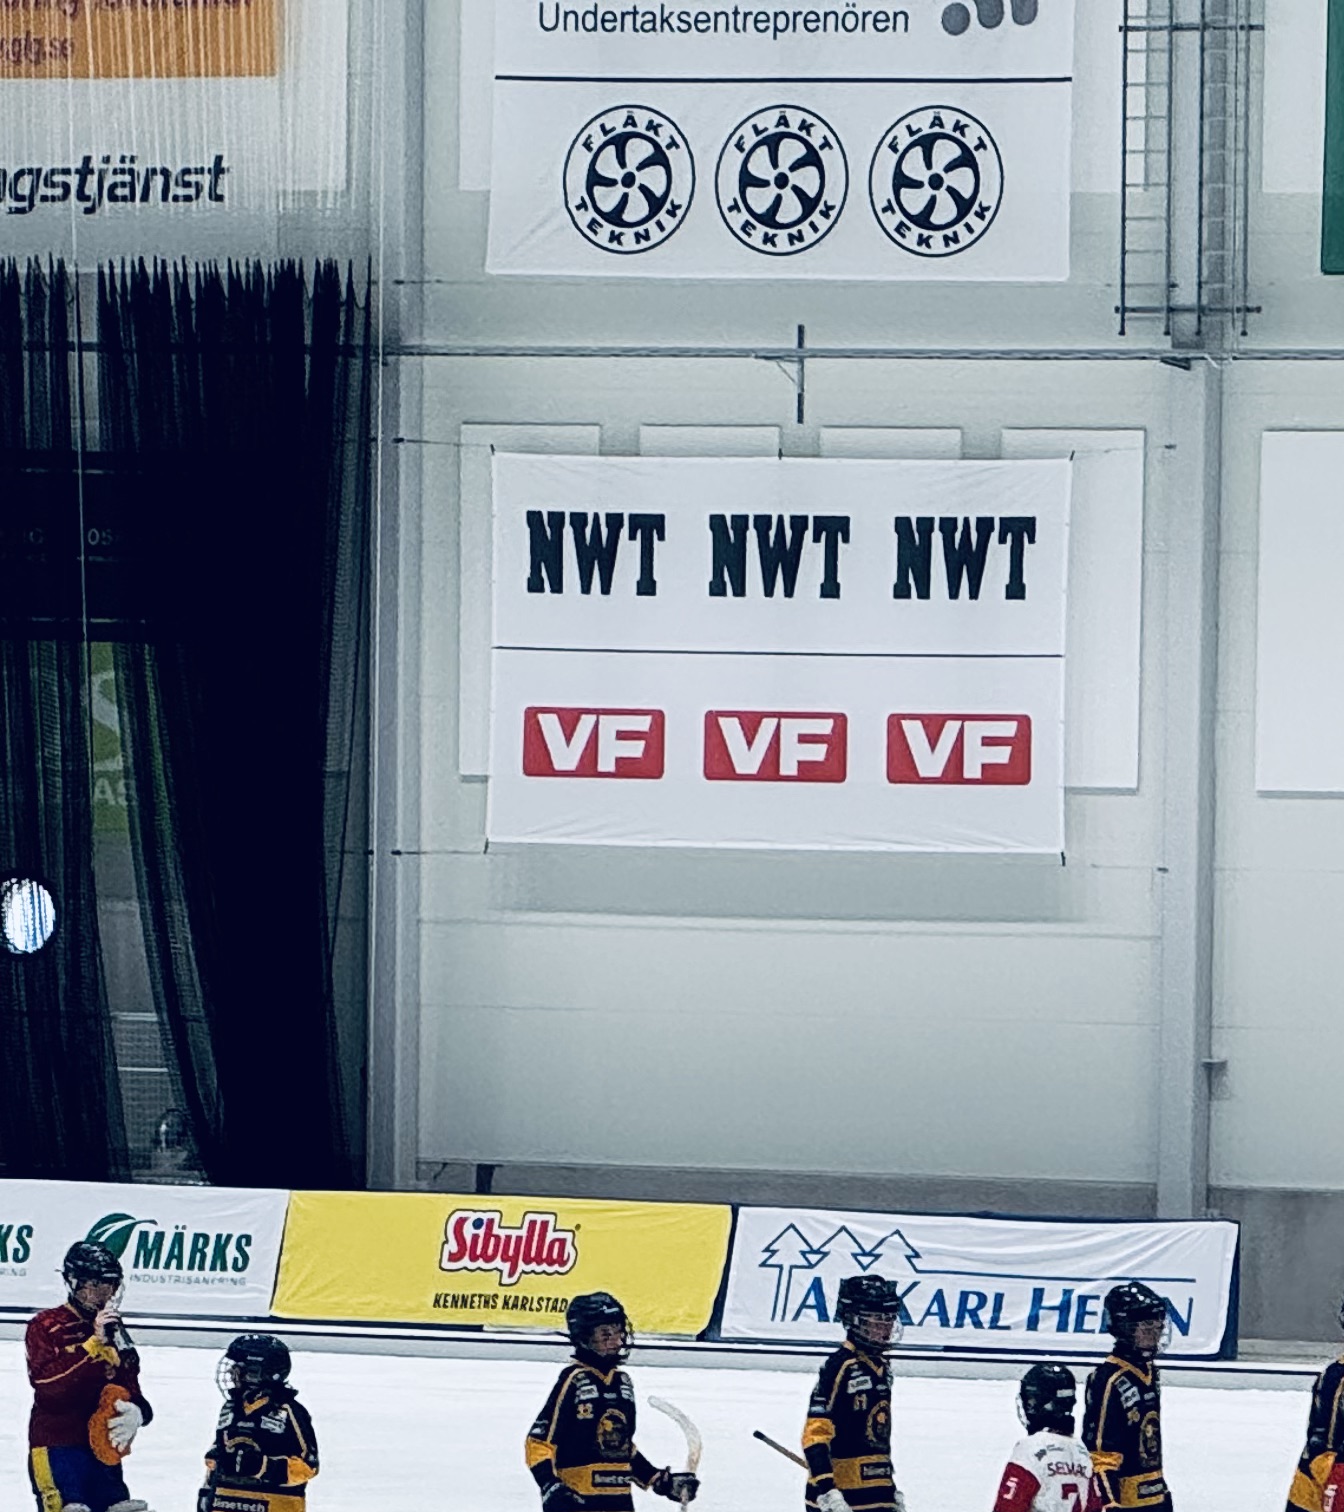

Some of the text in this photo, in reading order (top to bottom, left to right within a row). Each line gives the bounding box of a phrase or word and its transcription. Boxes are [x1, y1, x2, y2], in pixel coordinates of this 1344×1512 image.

[538, 2, 909, 39] Undertaksentreprenören
[583, 111, 680, 153] FLÄKT
[733, 111, 833, 153] FLÄKT
[887, 111, 989, 154] FLÄKT
[0, 154, 230, 214] gstjänst
[574, 197, 682, 249] TEKNIK
[726, 199, 835, 249] TEKNIK
[880, 199, 991, 250] TEKNIK
[526, 510, 1036, 600] NWT NWT NWT
[537, 713, 1017, 779] VF VF VF
[133, 1224, 252, 1273] MÄRKS
[448, 1216, 570, 1278] Sibylla
[433, 1292, 568, 1314] KENNETHS KARLSTAD
[1026, 1287, 1193, 1337] HEN
